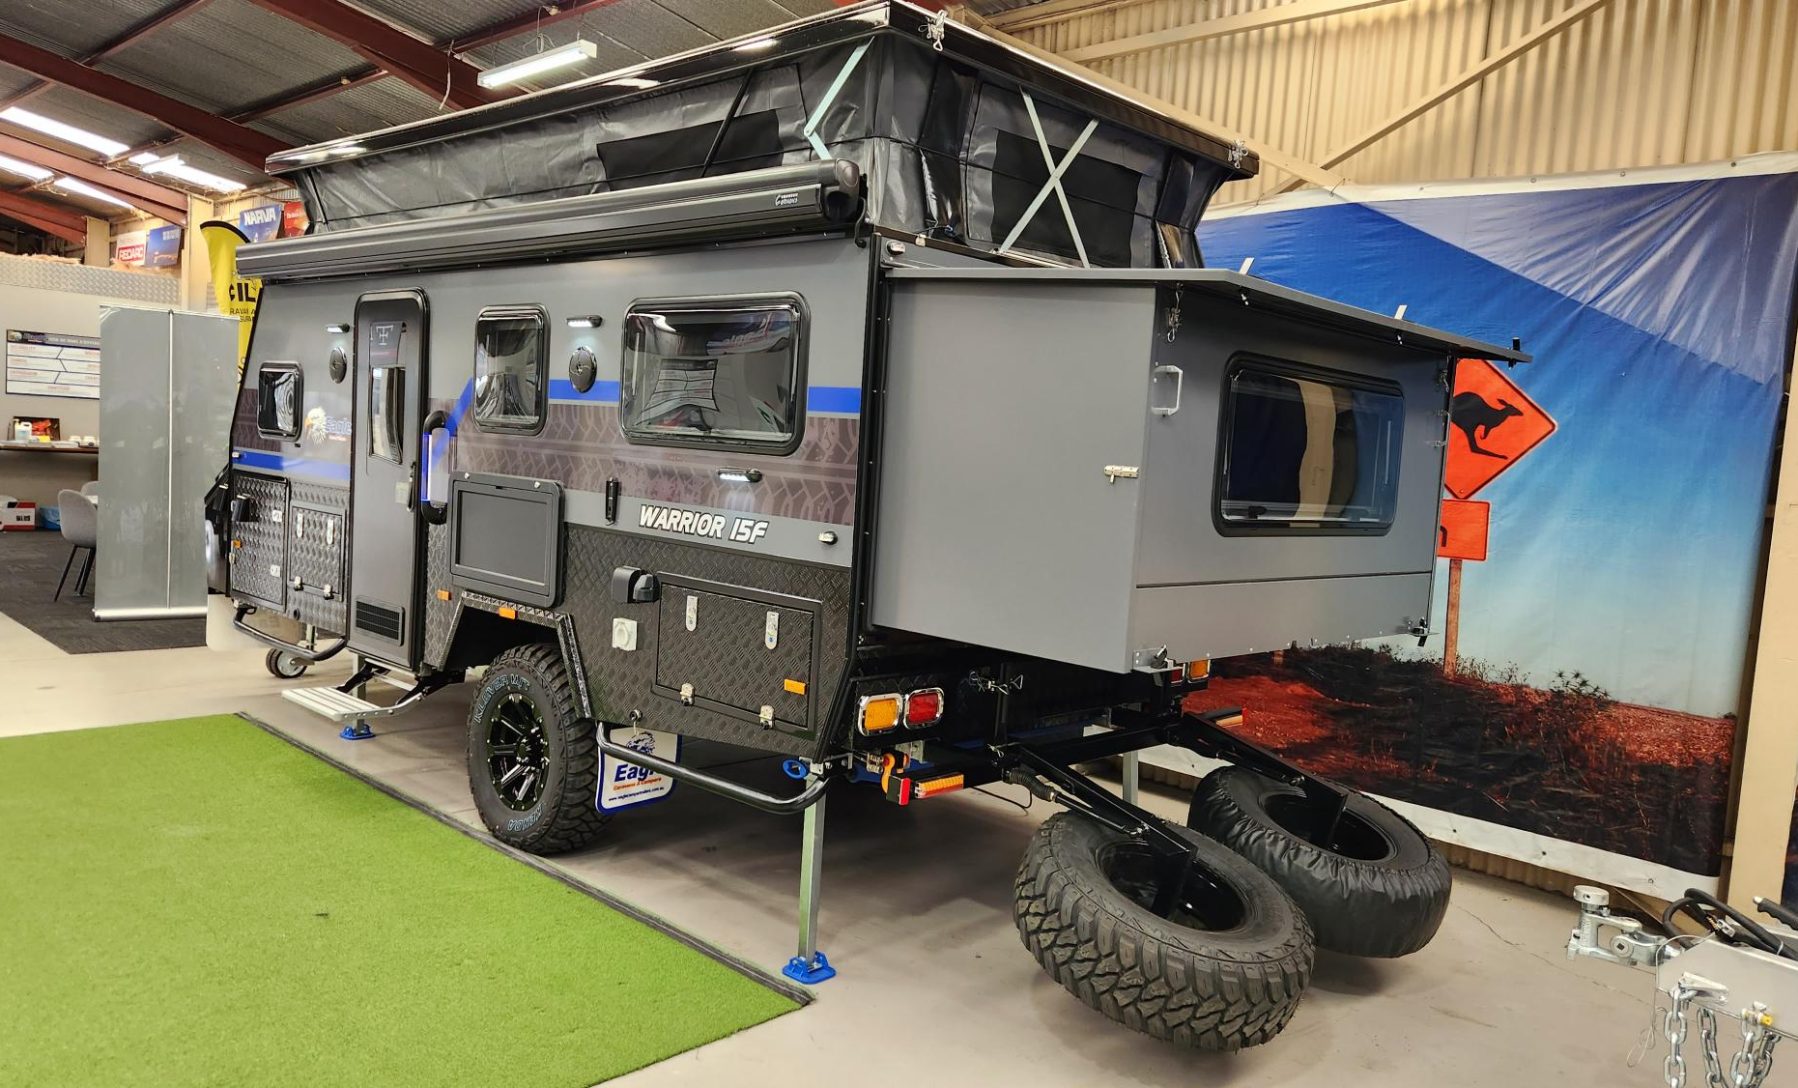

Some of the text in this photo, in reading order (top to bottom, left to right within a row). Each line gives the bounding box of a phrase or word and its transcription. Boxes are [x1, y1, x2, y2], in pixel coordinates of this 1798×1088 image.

[243, 207, 276, 226] NARVA
[638, 504, 769, 545] WARRIOR 15F
[473, 674, 508, 724] KLEVER
[614, 764, 654, 782] Eag
